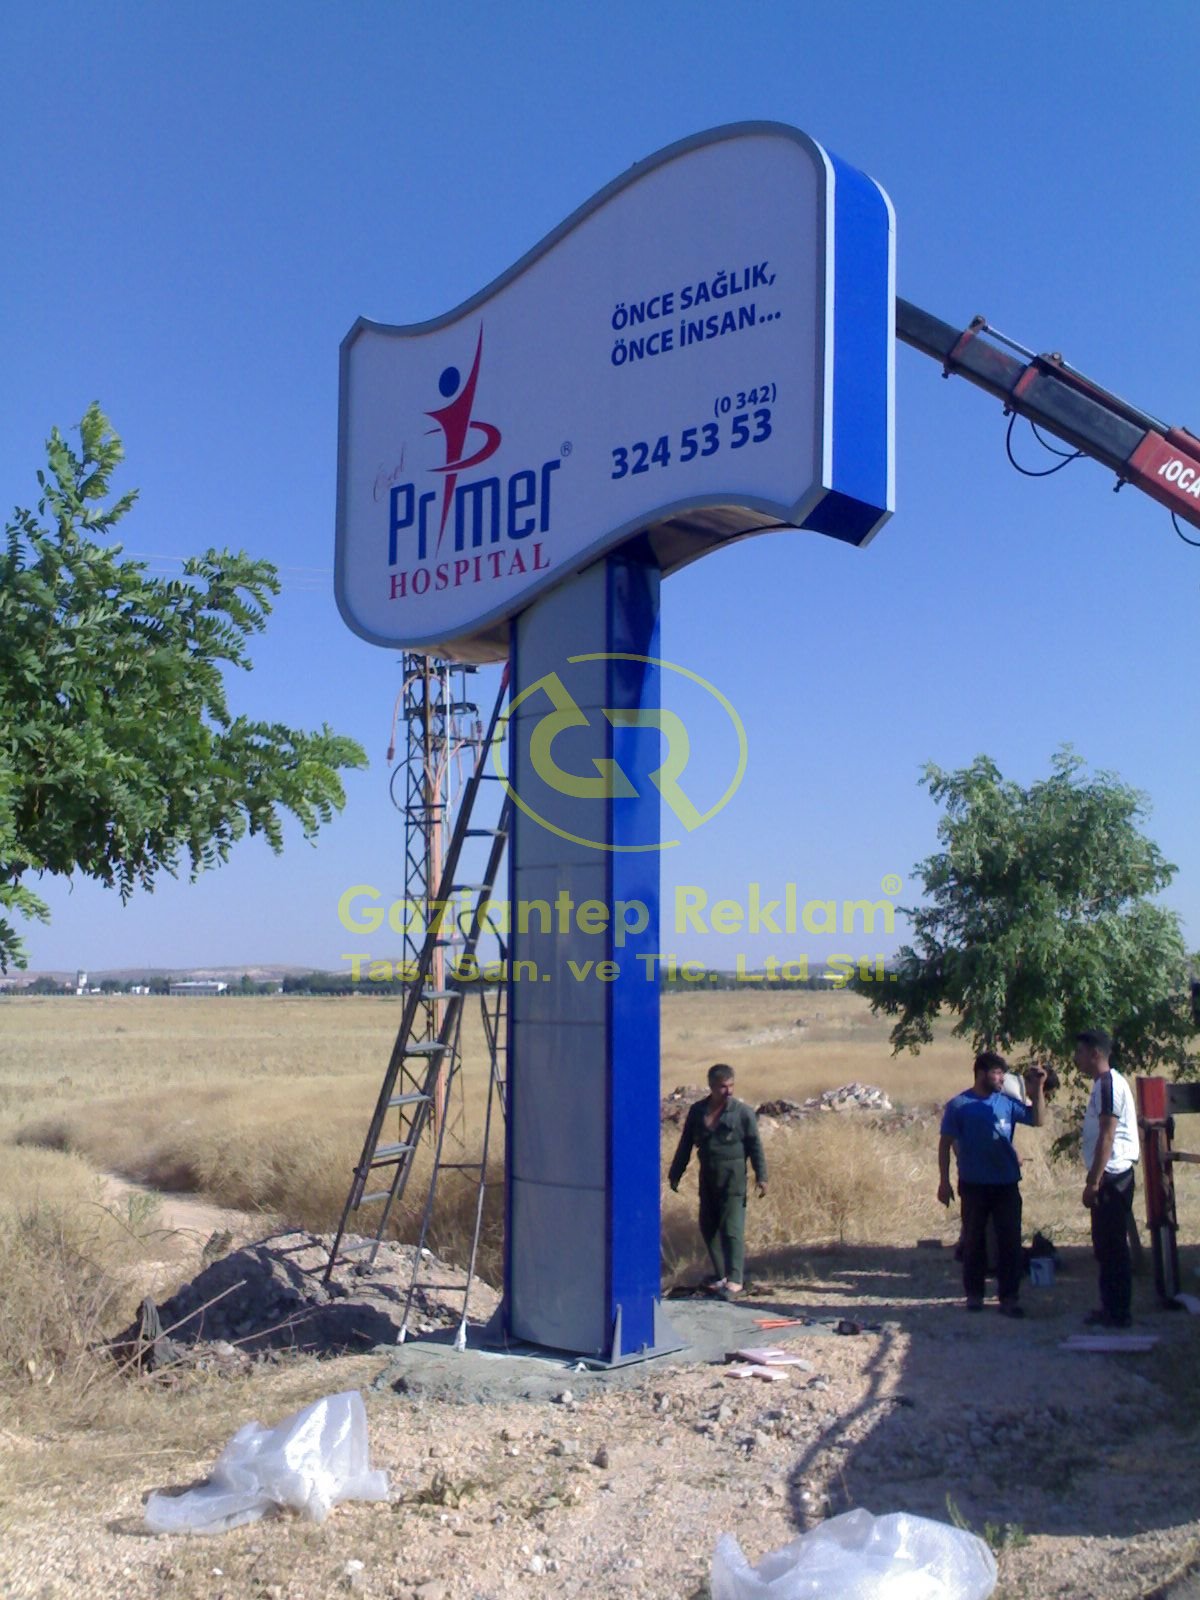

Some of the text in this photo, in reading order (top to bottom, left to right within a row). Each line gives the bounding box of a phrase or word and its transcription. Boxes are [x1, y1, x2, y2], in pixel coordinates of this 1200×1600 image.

[611, 261, 776, 331] ÖNCE SAĞLIK,
[611, 303, 781, 367] ÖNCE İNSAN...
[714, 382, 777, 418] (0 342)
[611, 408, 772, 480] 324 53 53
[388, 542, 551, 600] HOSPITAL
